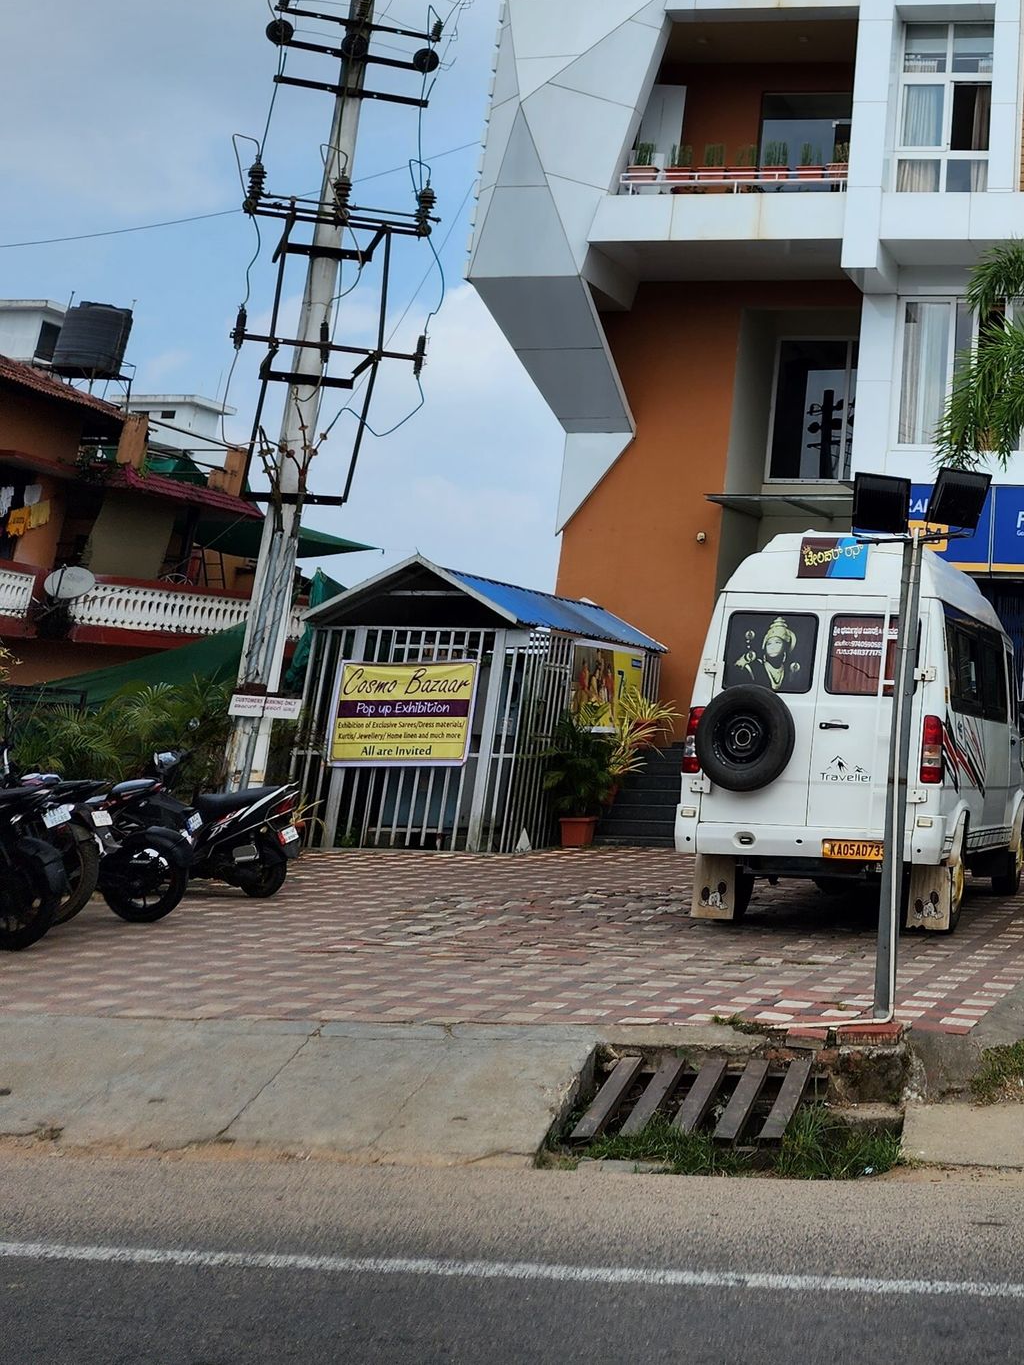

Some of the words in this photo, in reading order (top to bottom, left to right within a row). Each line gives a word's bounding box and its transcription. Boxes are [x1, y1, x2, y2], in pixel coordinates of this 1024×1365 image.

[343, 668, 397, 696] Cosmo
[404, 668, 470, 695] Bazaar
[356, 702, 376, 717] Pop
[378, 705, 392, 717] up
[395, 701, 450, 714] Exhibition
[338, 721, 364, 729] Exhibition
[365, 721, 372, 729] of
[372, 721, 397, 729] Exclusive
[361, 746, 375, 756] All
[377, 748, 392, 756] are
[395, 745, 432, 756] Invited
[820, 772, 871, 782] Traveller
